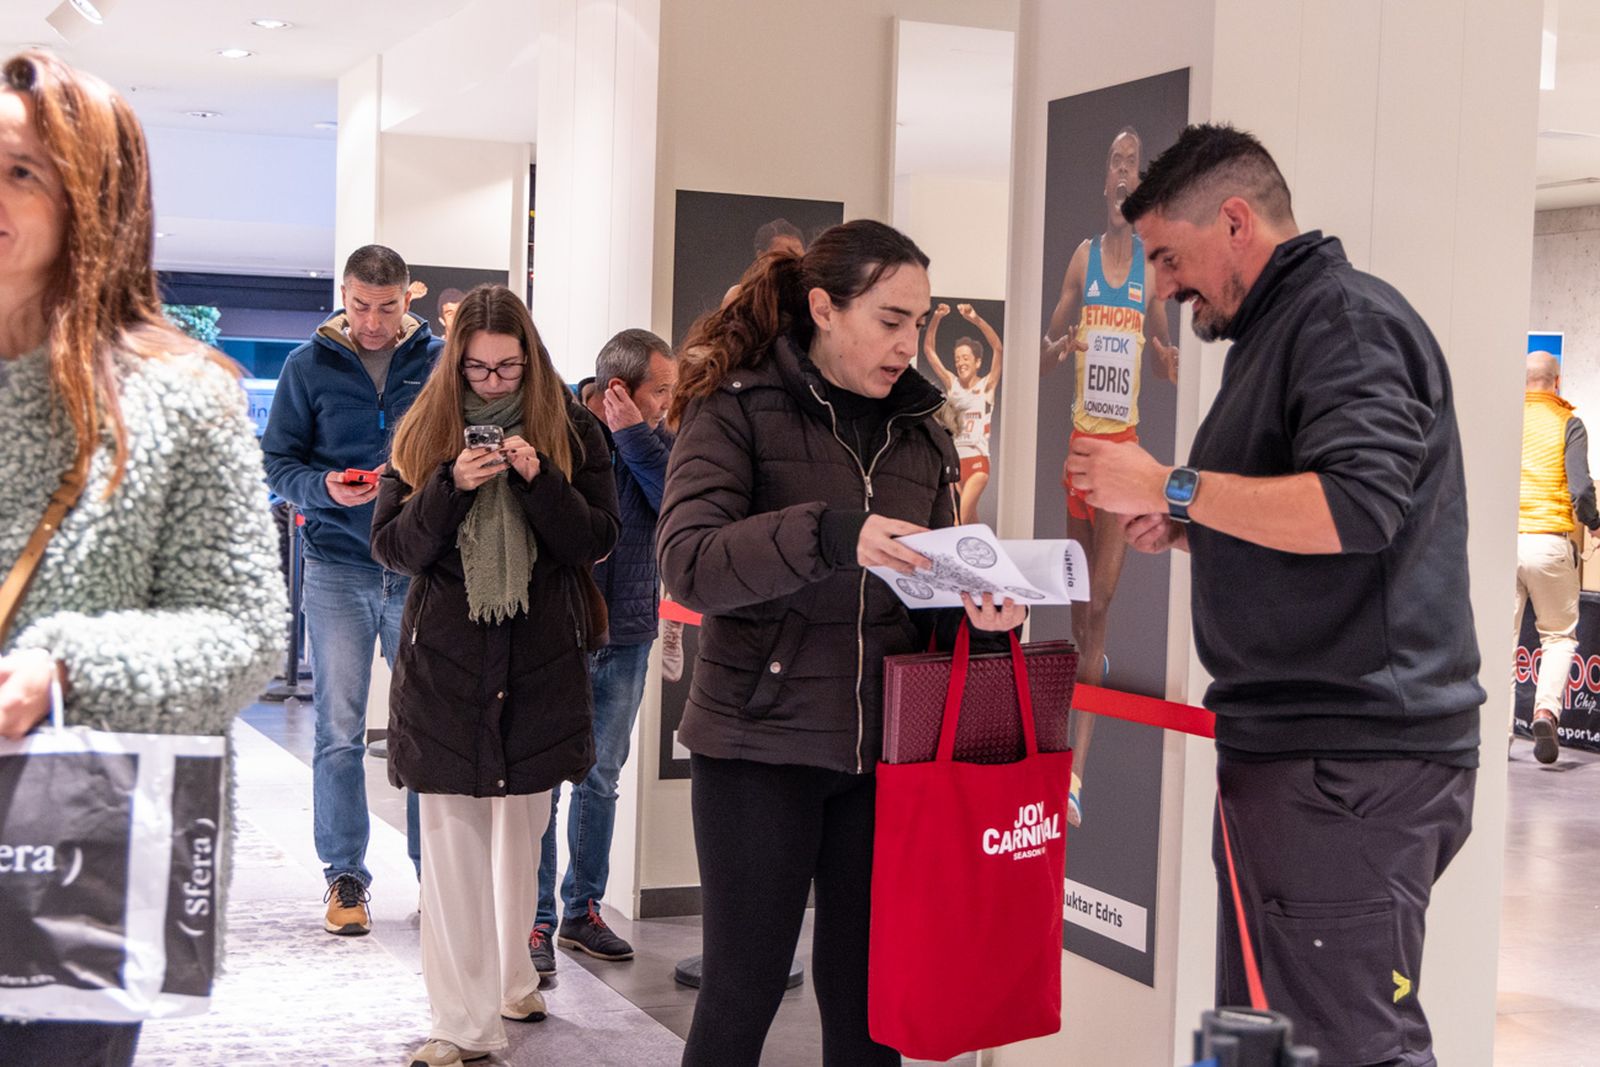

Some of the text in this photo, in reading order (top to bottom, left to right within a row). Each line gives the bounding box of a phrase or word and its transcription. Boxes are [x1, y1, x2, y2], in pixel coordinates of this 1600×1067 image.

[1102, 336, 1130, 354] TDK
[1088, 364, 1130, 396] EDRIS
[1084, 400, 1114, 415] LONDON
[1064, 549, 1076, 588] isteria
[1574, 692, 1598, 714] Chip
[1556, 726, 1600, 743] eport.e
[1013, 800, 1044, 829] JOY
[982, 813, 1061, 855] CARNIVAL
[1063, 889, 1123, 928] uktar Edris
